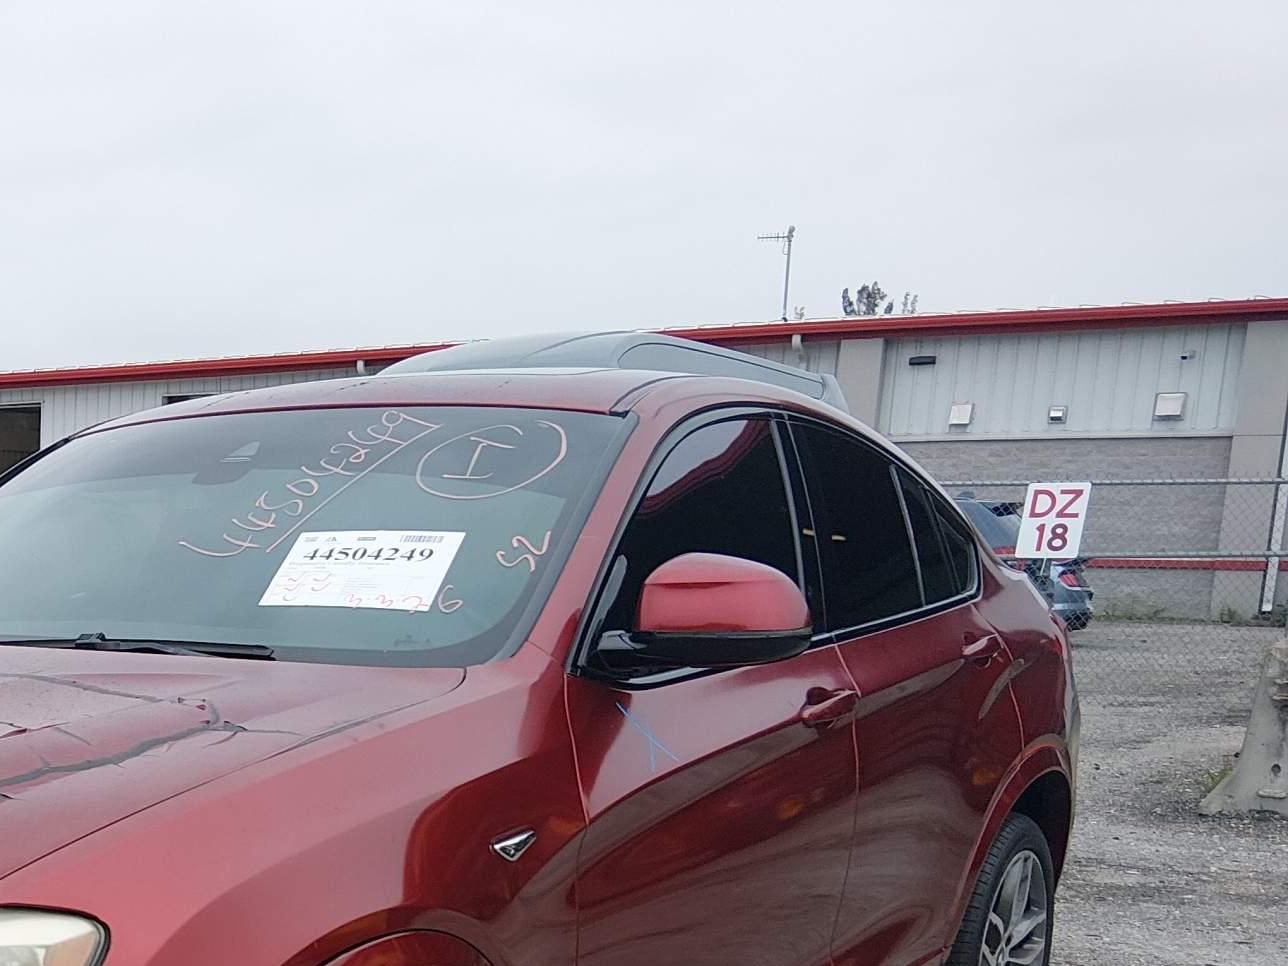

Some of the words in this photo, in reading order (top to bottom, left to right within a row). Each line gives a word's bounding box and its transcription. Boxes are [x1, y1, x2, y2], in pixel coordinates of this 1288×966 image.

[1028, 489, 1085, 518] DZ
[1035, 523, 1069, 552] 18
[303, 547, 435, 562] 44504249
